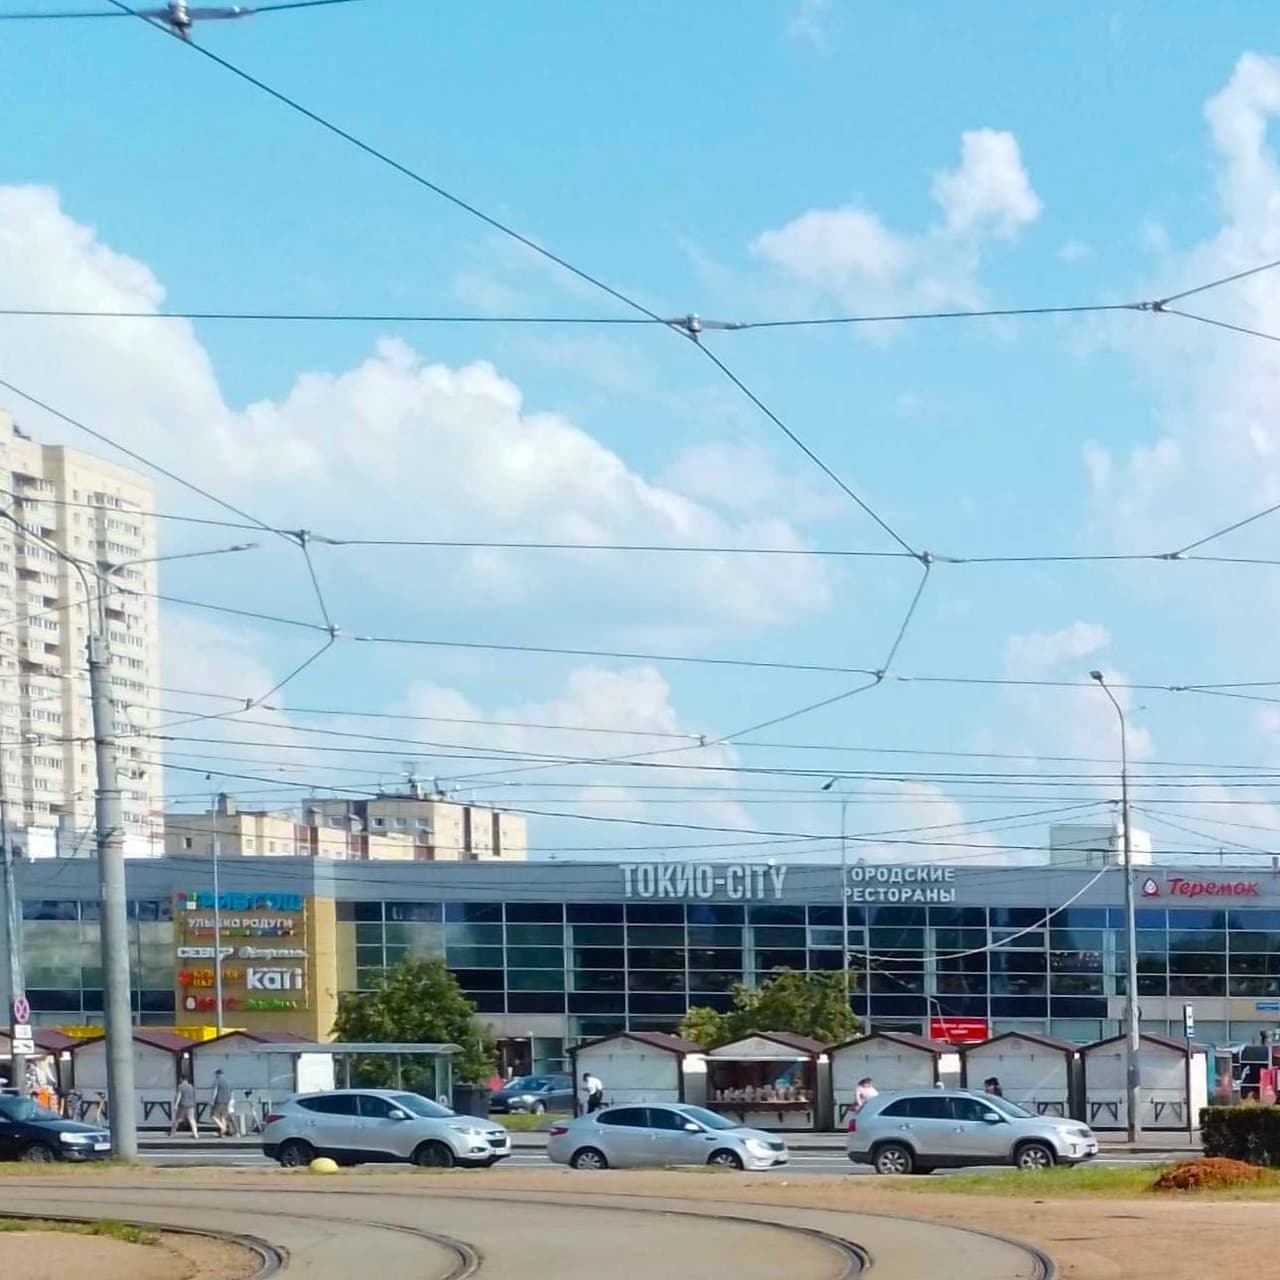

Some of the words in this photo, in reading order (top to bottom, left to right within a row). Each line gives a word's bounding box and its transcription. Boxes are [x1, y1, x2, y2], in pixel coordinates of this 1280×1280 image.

[851, 866, 956, 884] ОРОДСКИЕ
[1167, 878, 1260, 898] Теремок
[246, 967, 303, 990] kari
